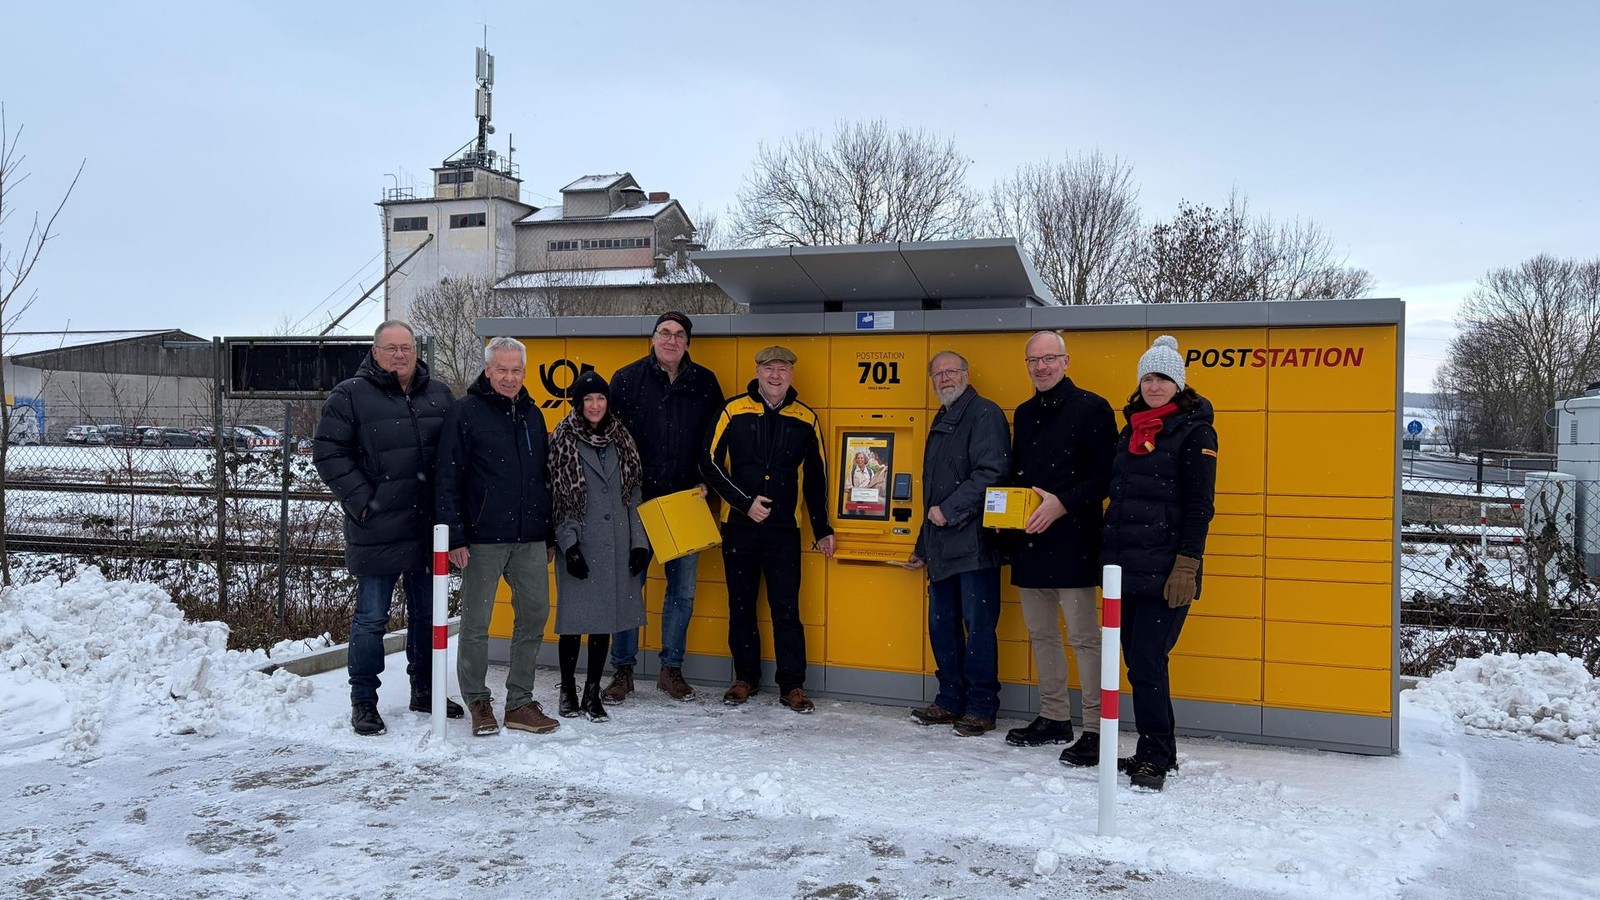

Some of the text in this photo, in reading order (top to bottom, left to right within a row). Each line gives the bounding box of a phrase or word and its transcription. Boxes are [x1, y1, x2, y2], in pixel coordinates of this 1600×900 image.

[856, 351, 905, 360] POSTSTATION
[1184, 347, 1364, 368] POSTSTATION
[857, 361, 901, 385] 701
